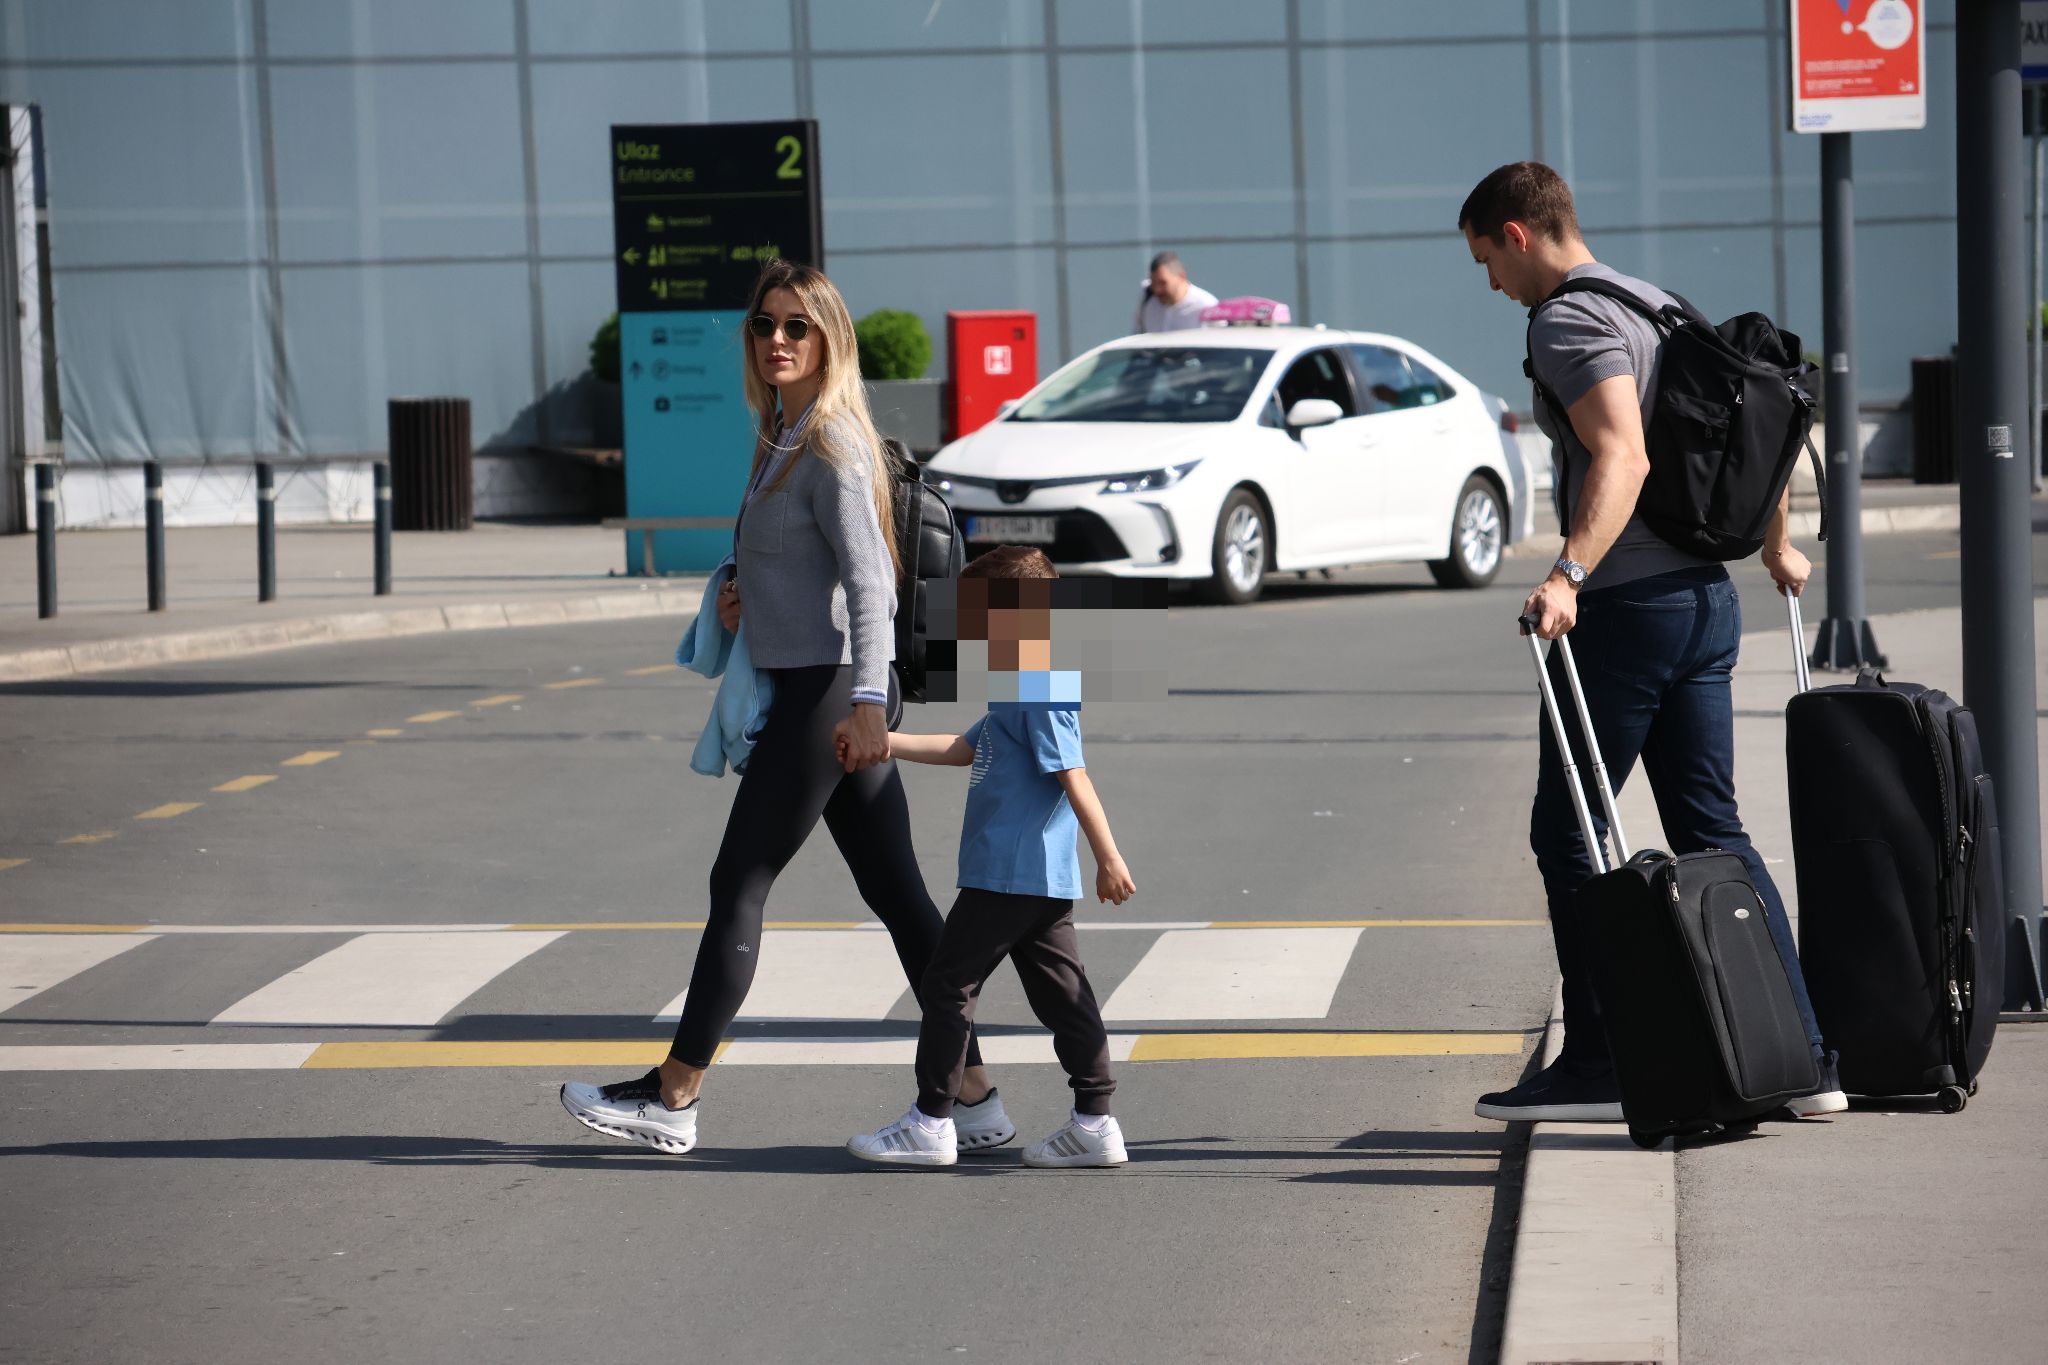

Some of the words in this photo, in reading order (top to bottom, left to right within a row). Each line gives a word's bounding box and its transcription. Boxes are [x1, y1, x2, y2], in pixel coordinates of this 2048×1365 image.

[616, 141, 661, 160] Ulaz
[775, 135, 802, 179] 2
[618, 166, 696, 184] Entrance
